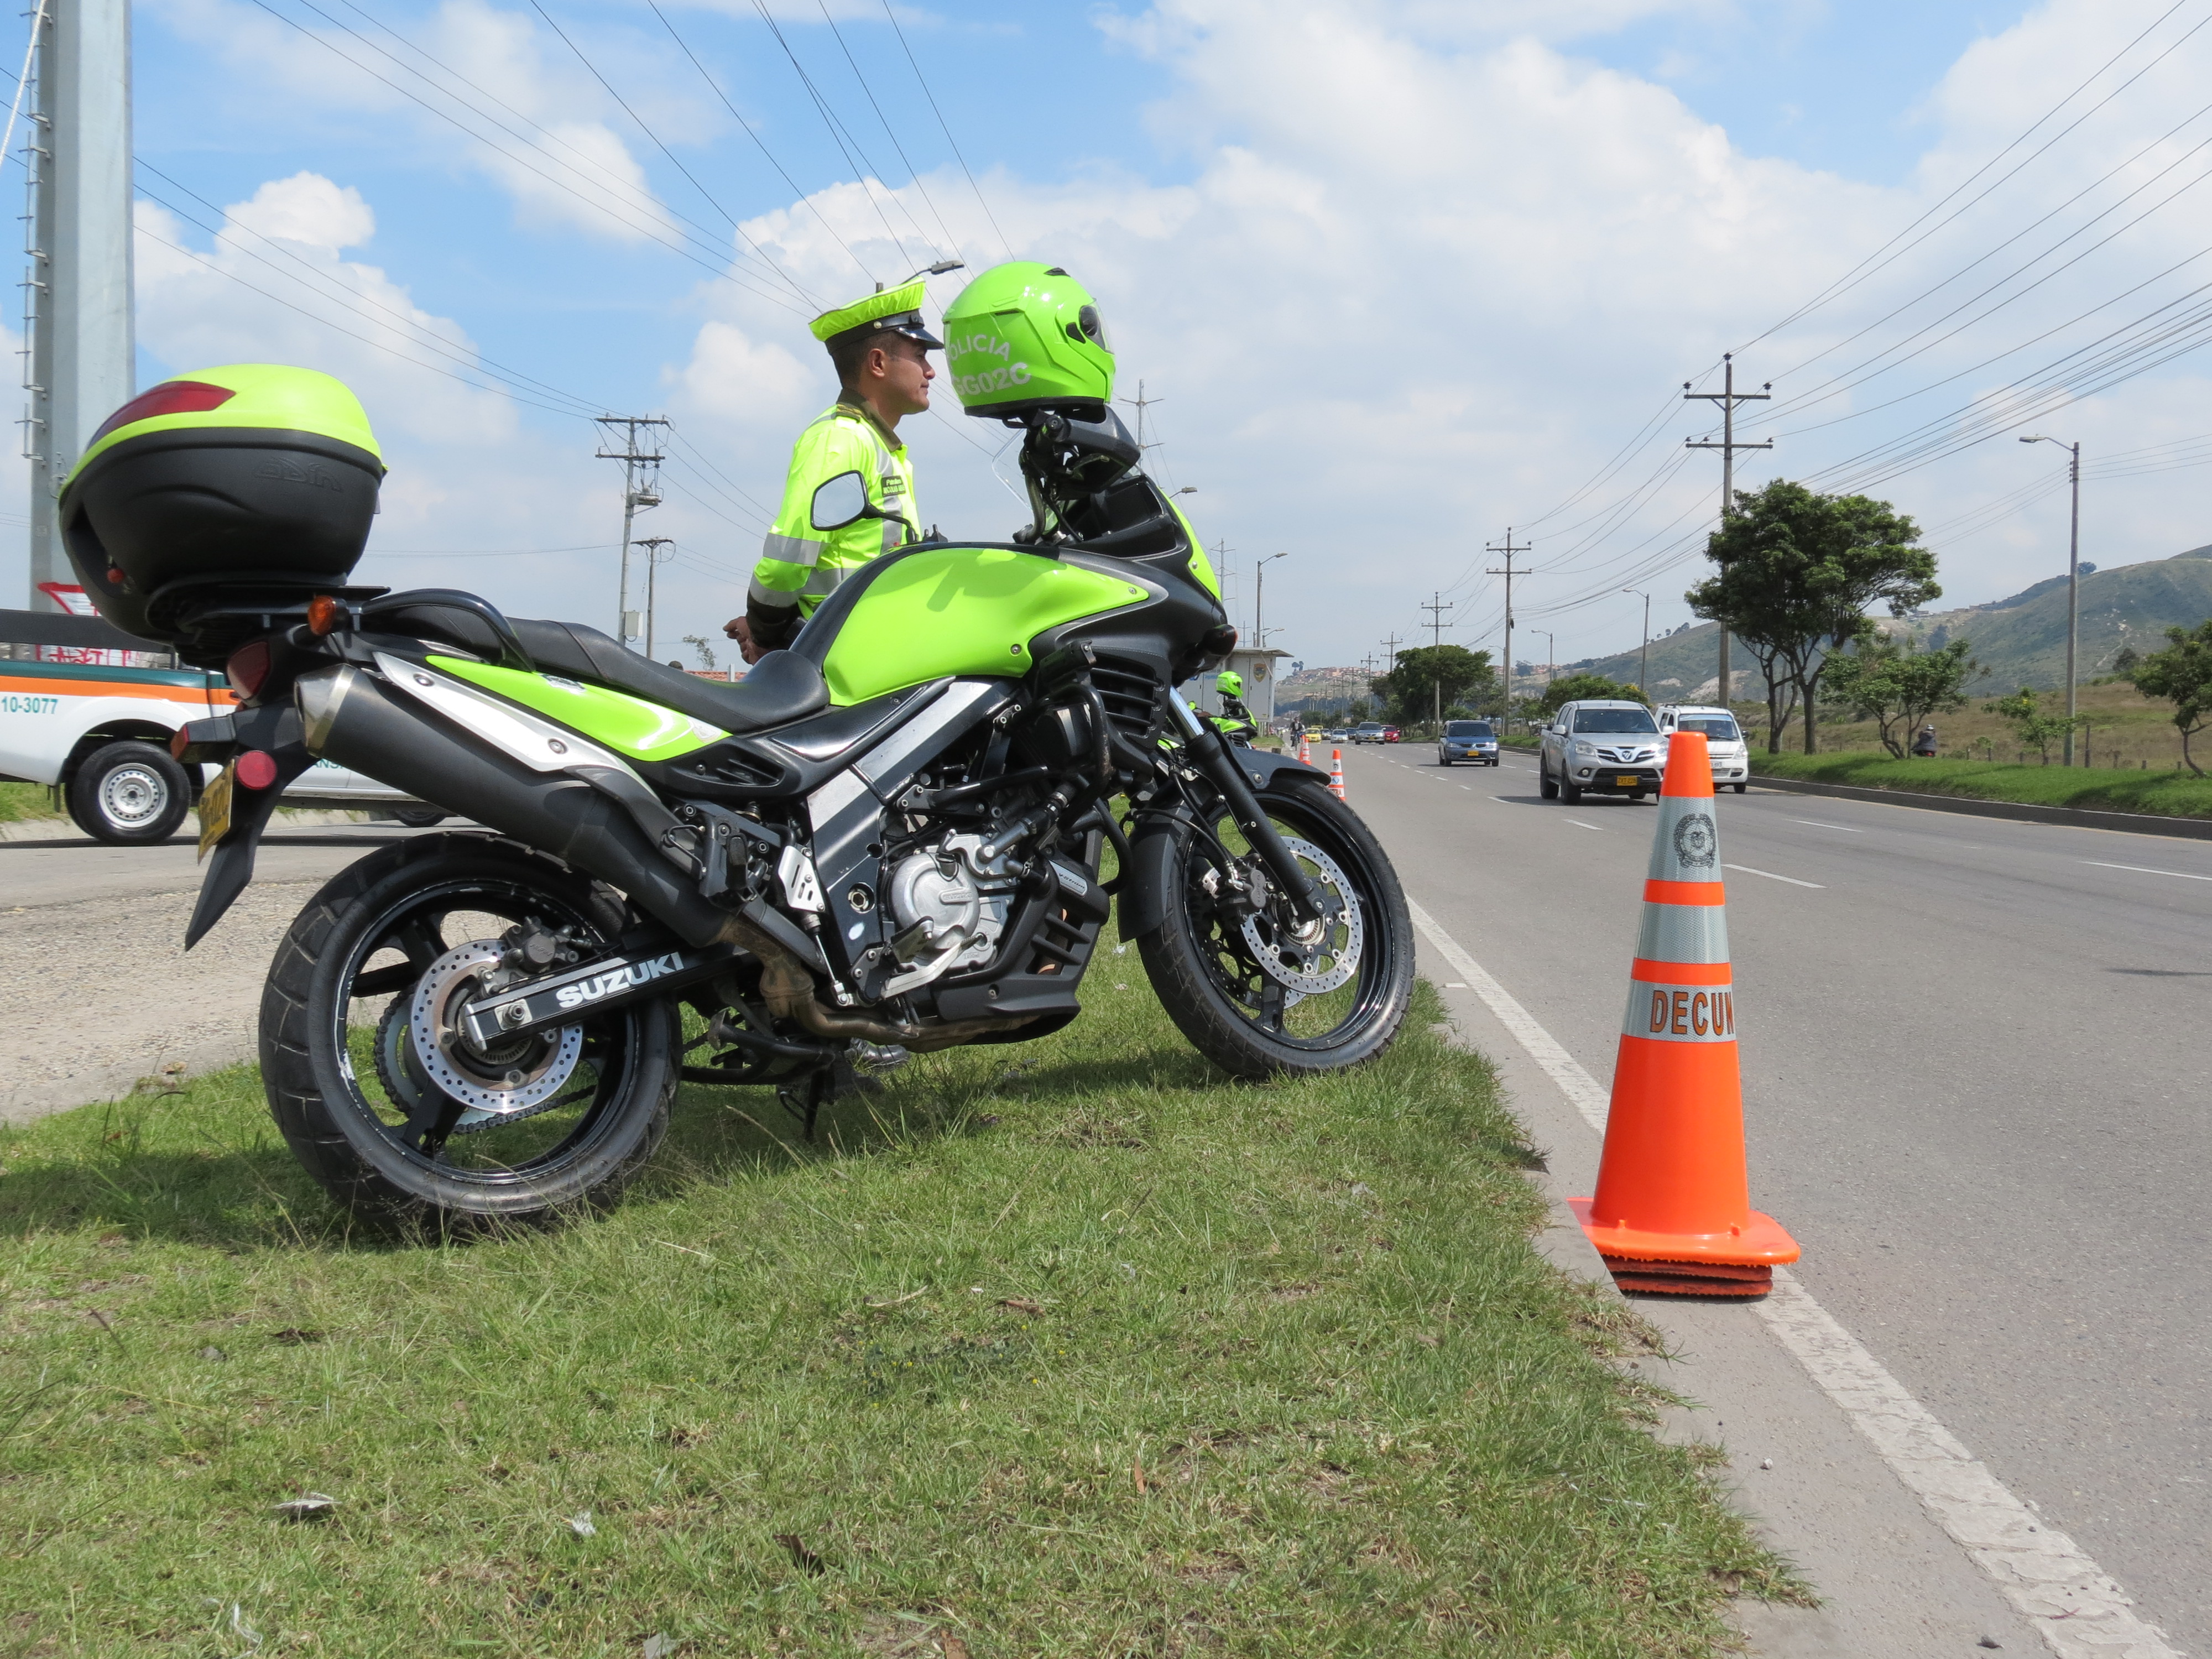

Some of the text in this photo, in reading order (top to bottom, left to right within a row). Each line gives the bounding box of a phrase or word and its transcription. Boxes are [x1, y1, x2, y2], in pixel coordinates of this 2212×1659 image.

[948, 334, 1010, 362] OLICIA
[1, 696, 58, 714] 10-3077
[556, 952, 684, 1008] SUZUKI
[1650, 990, 1734, 1036] DECUN
